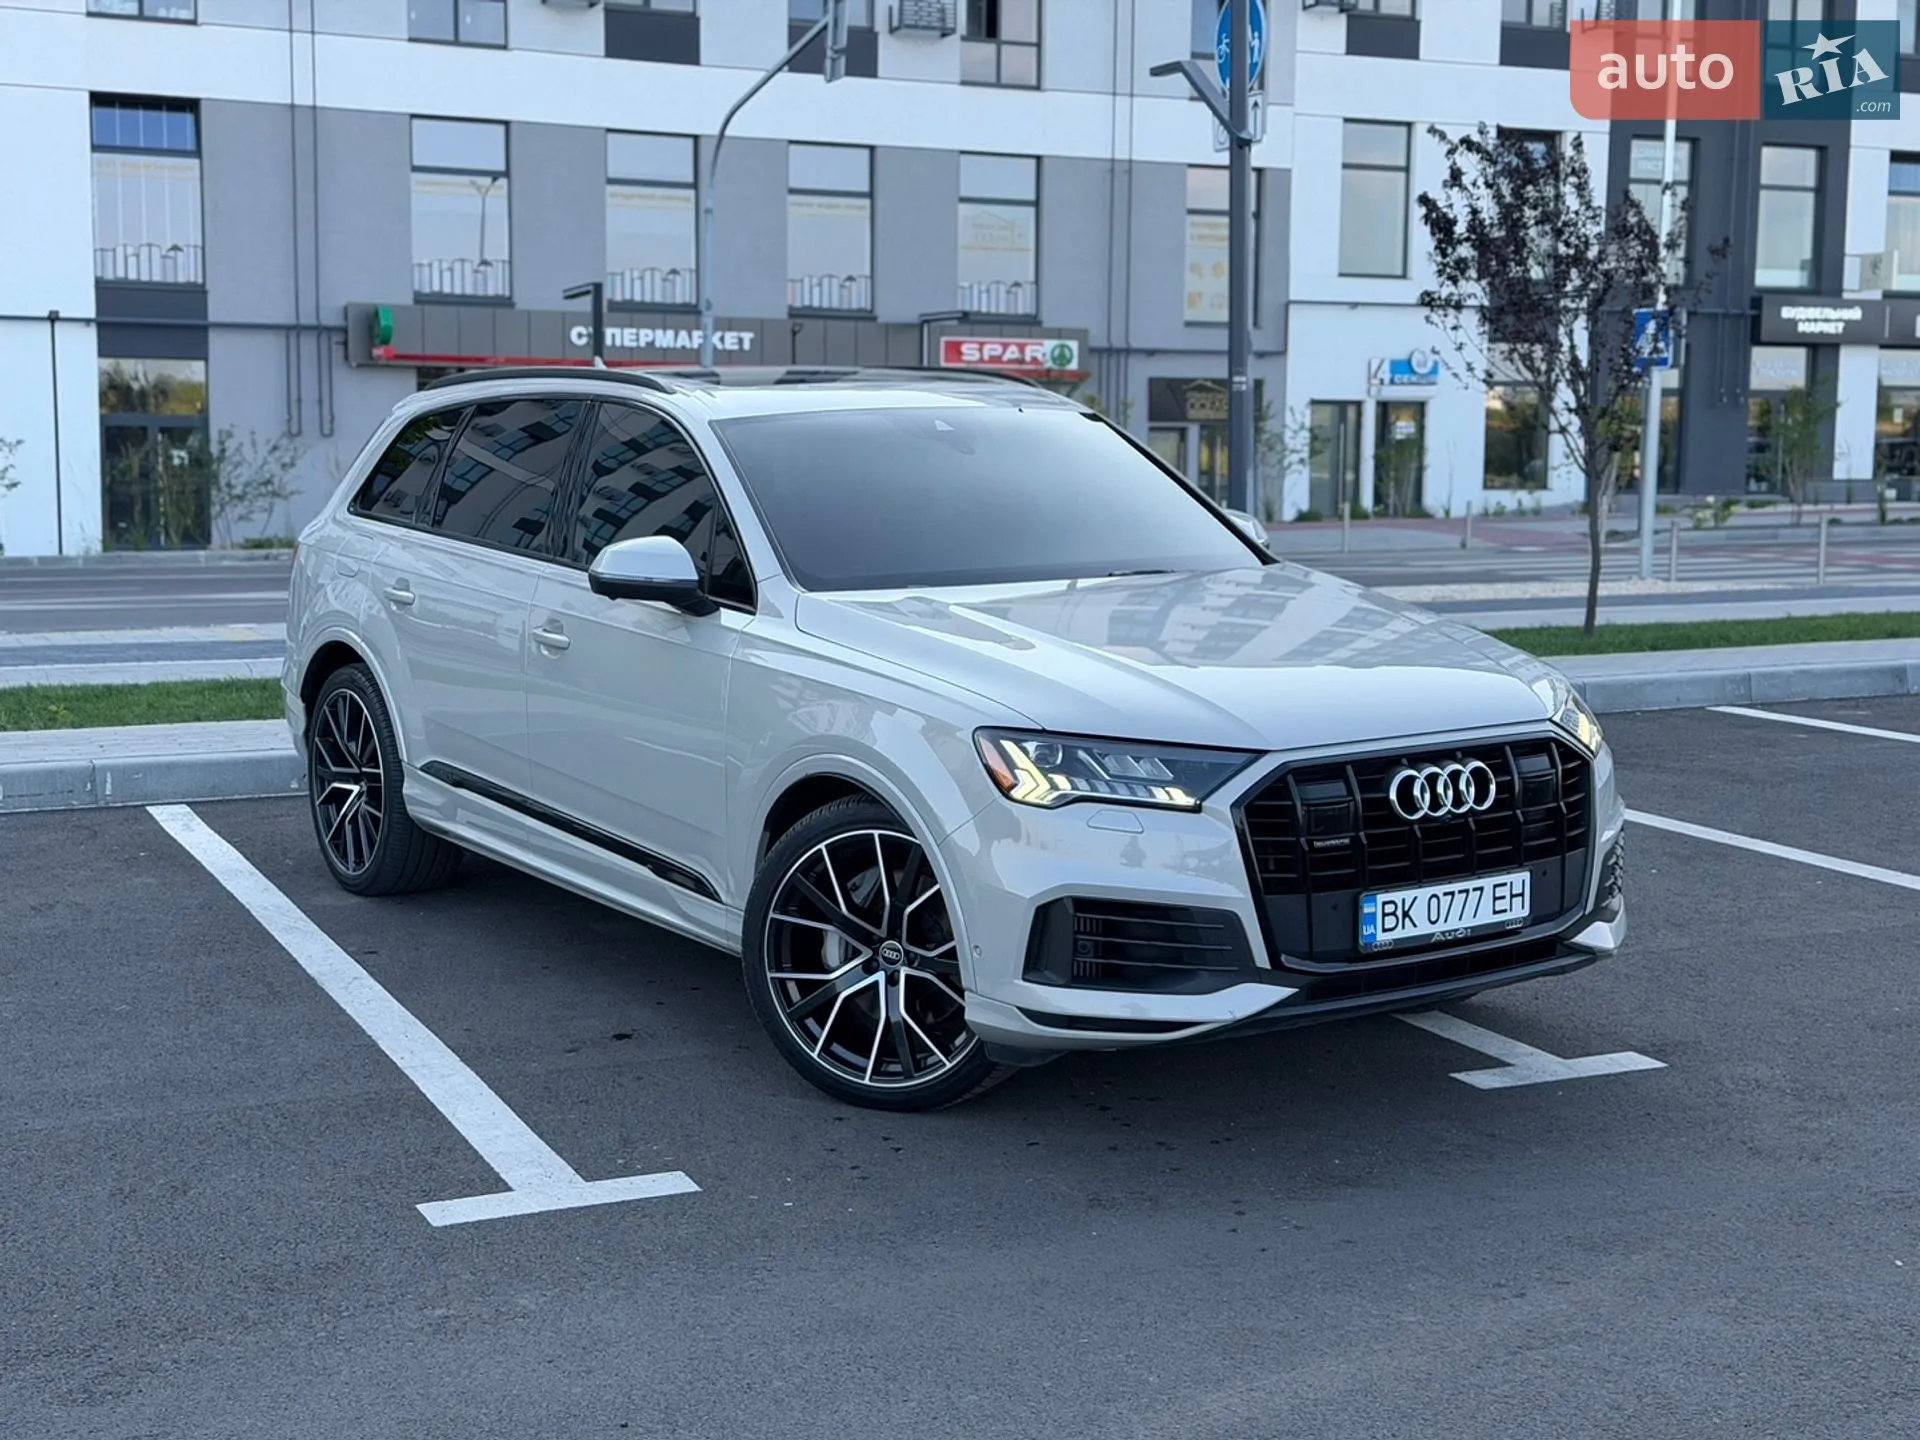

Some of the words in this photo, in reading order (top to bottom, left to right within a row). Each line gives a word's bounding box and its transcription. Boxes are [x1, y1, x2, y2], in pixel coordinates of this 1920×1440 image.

[570, 326, 754, 350] СПЕРМАРКЕТ
[961, 342, 1046, 363] SPAR
[1381, 895, 1419, 933] BK
[1427, 886, 1485, 925] 0777
[1492, 879, 1526, 916] EH
[1363, 924, 1376, 935] UA
